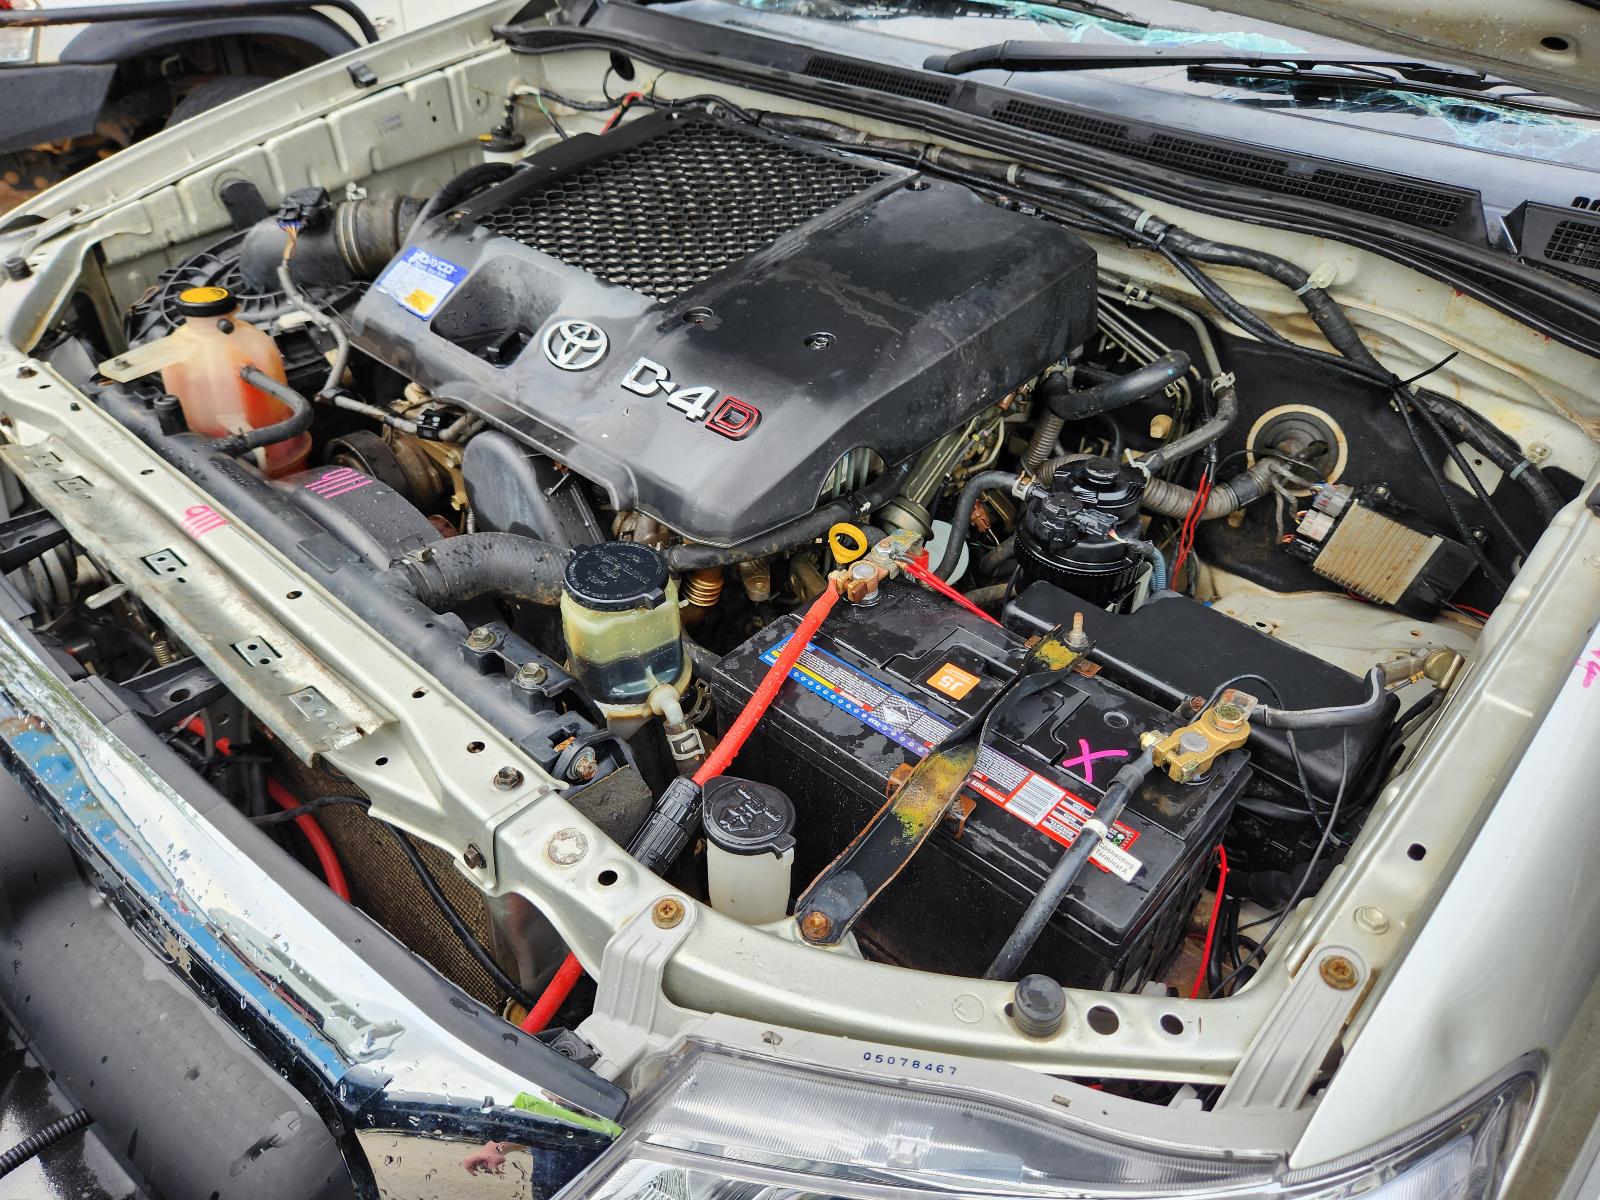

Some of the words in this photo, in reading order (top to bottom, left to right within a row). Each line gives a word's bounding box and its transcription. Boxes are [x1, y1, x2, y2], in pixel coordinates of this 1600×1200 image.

[621, 356, 763, 441] D-4D
[970, 778, 985, 790] DATE
[983, 786, 1005, 803] FITTING
[1095, 849, 1123, 872] Terminal
[1098, 841, 1135, 870] Connecting
[863, 1052, 957, 1075] 05078467
